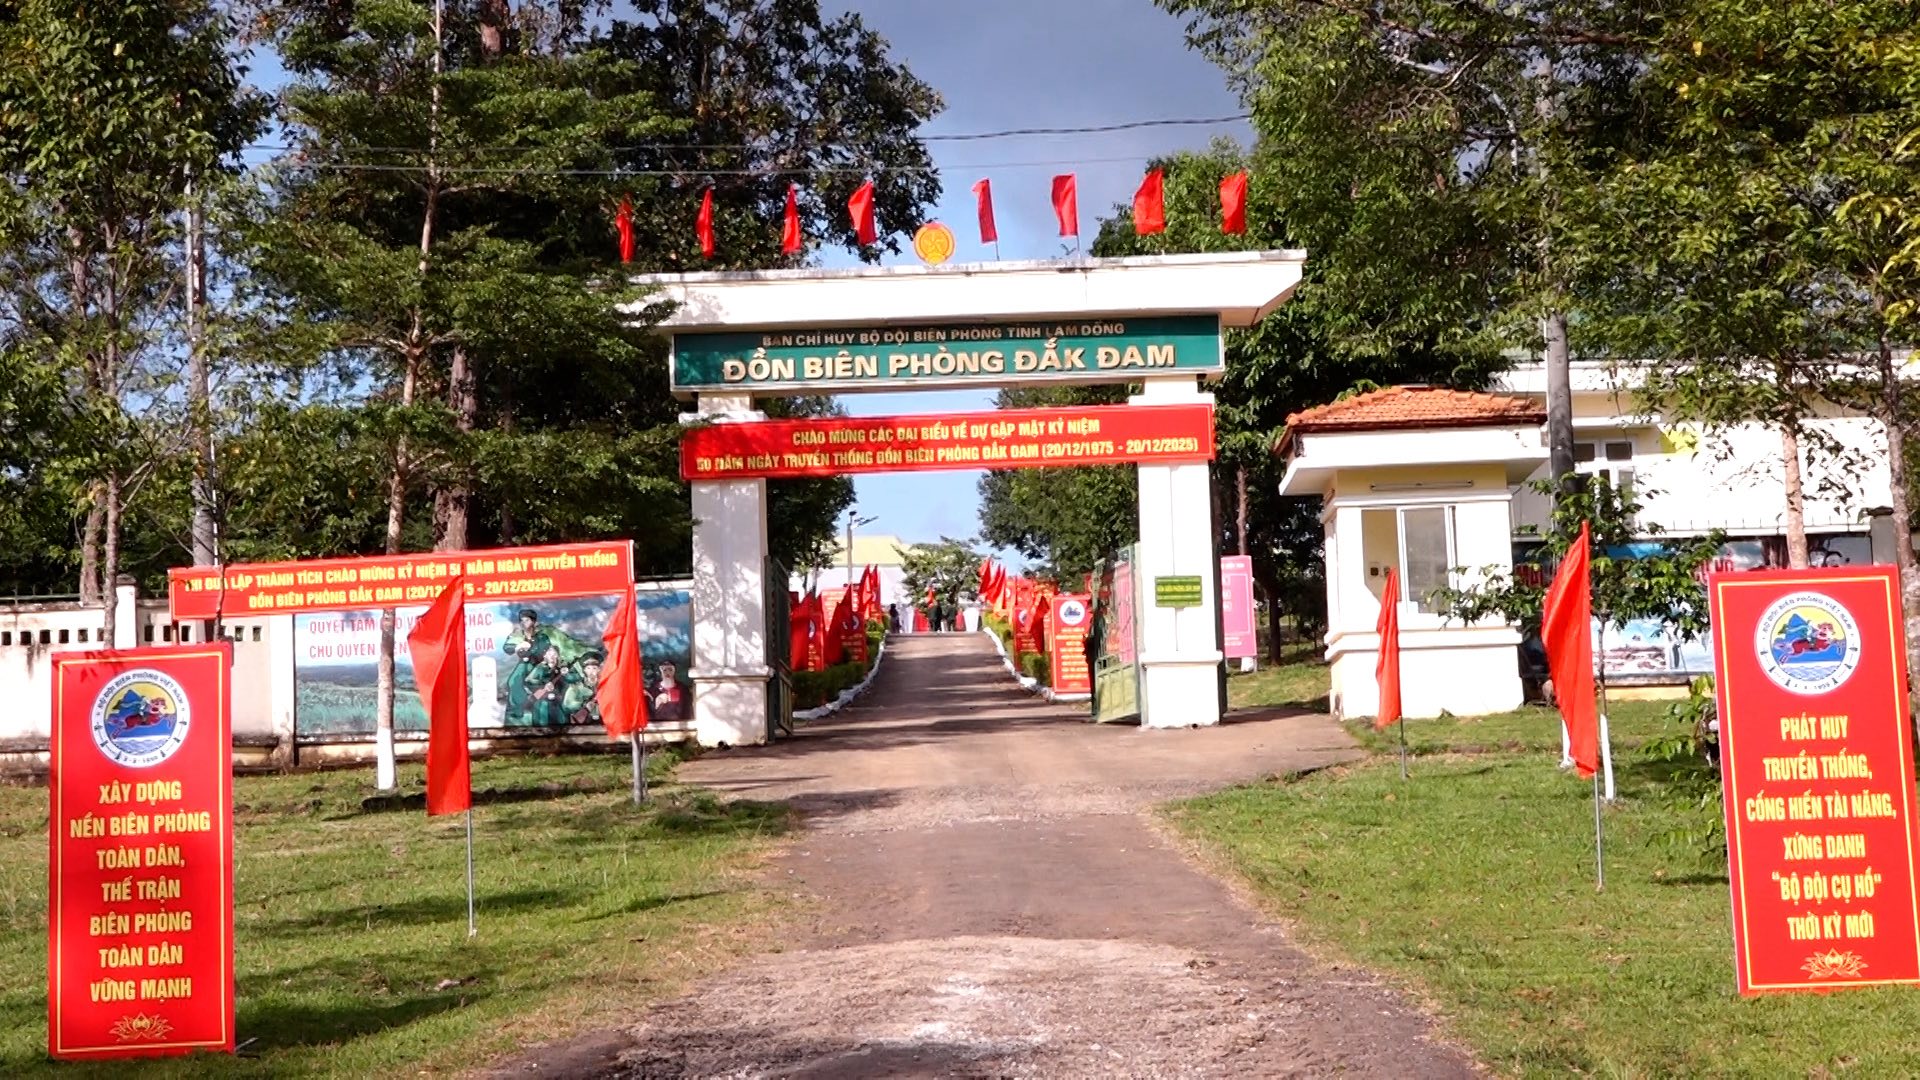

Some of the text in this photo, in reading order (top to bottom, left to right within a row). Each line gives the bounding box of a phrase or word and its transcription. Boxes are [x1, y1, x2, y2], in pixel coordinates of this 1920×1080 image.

[762, 335, 793, 347] BAN
[824, 333, 855, 345] HUY
[723, 337, 1175, 381] ĐỒN BIÊN PHÒNG ĐẮK ĐAM
[869, 426, 893, 442] CÁC
[1067, 418, 1100, 436] NIỆM
[938, 443, 979, 462] PHÒNG
[1042, 440, 1114, 458] (20/12/1975
[1126, 437, 1198, 453] 20/12/2025)
[256, 571, 294, 588] THÀNH
[297, 569, 323, 586] TÍCH
[325, 567, 357, 583] CHÀO
[416, 561, 446, 580] NIỆM
[497, 557, 528, 573] NGÀY
[276, 591, 304, 607] BIÊN
[306, 589, 347, 606] PHÒNG
[485, 578, 553, 594] 20/12/2025)
[474, 637, 494, 652] GIA
[1780, 712, 1848, 741] PHÁT HUY
[1820, 747, 1873, 780] THỐNG,
[99, 780, 181, 805] XÂY DỰNG
[1745, 788, 1897, 821] CỐNG HIẾN TÀI NĂNG,
[110, 810, 149, 836] BIÊN
[154, 808, 210, 834] PHÒNG
[96, 843, 185, 869] TOÀN DÂN,
[1783, 832, 1866, 860] XỨNG DANH
[101, 875, 181, 904] THẾ TRẬN
[1803, 870, 1828, 905] ĐỘI
[1831, 873, 1851, 904] CỤ
[90, 907, 192, 936] BIÊN PHÒNG
[1846, 910, 1875, 939] MỚI
[99, 941, 183, 968] TOÀN DÂN
[90, 977, 192, 1004] VỮNG MẠNH
